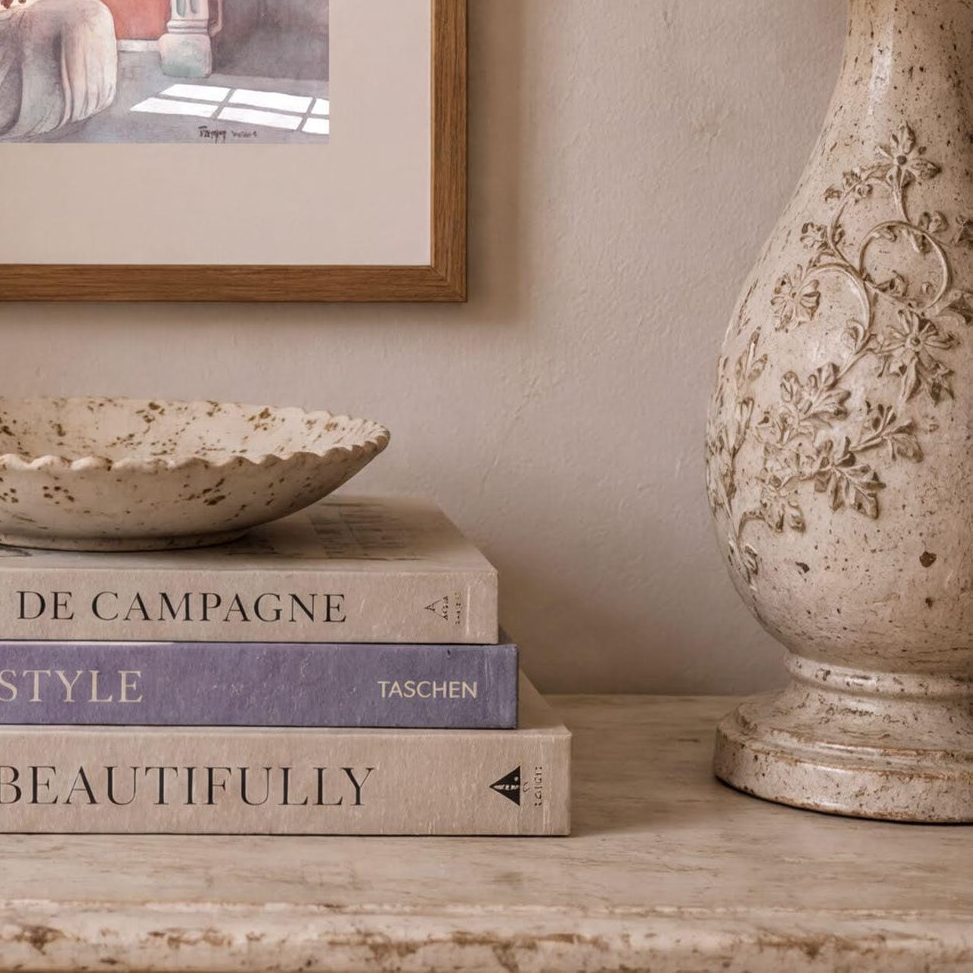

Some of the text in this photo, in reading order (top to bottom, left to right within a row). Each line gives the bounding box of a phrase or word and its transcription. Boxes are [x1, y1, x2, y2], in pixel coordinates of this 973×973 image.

[17, 590, 75, 621] DE
[91, 590, 347, 623] CAMPAGNE
[377, 680, 478, 700] TASCHEN
